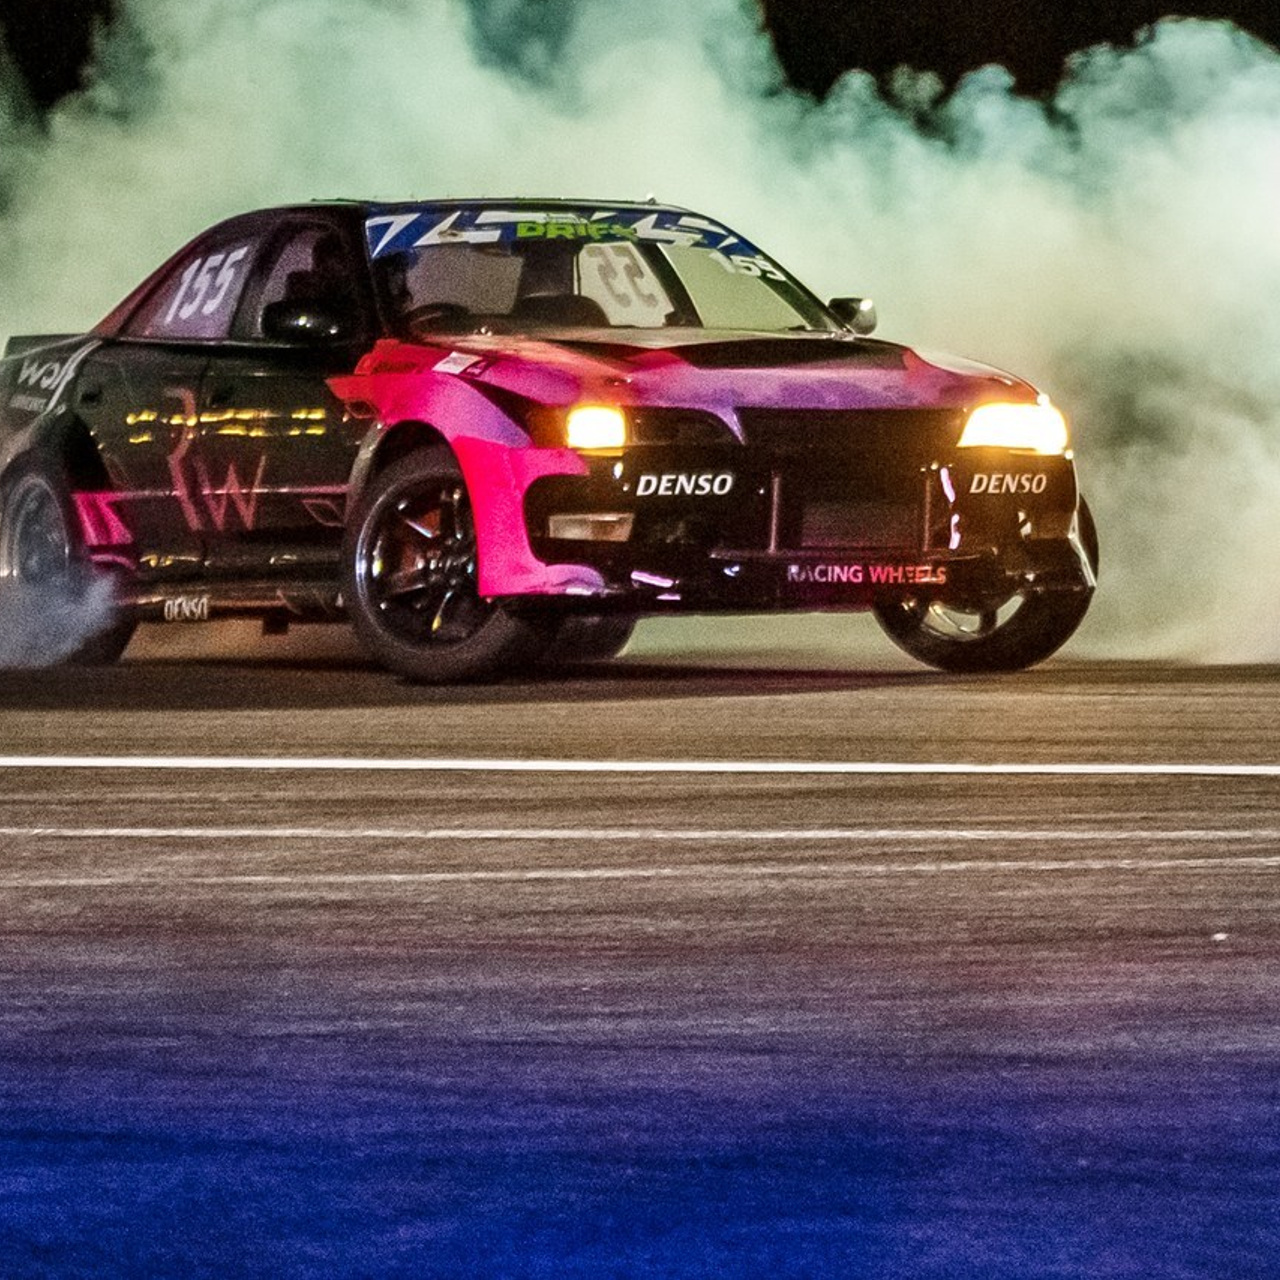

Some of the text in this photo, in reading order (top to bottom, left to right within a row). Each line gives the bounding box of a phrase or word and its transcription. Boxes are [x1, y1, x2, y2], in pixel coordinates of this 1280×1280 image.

[164, 246, 249, 325] 155
[636, 474, 734, 496] DENSO
[969, 474, 1048, 494] DENSO
[787, 565, 947, 585] RACING WHEELS
[163, 596, 209, 620] DENSO
